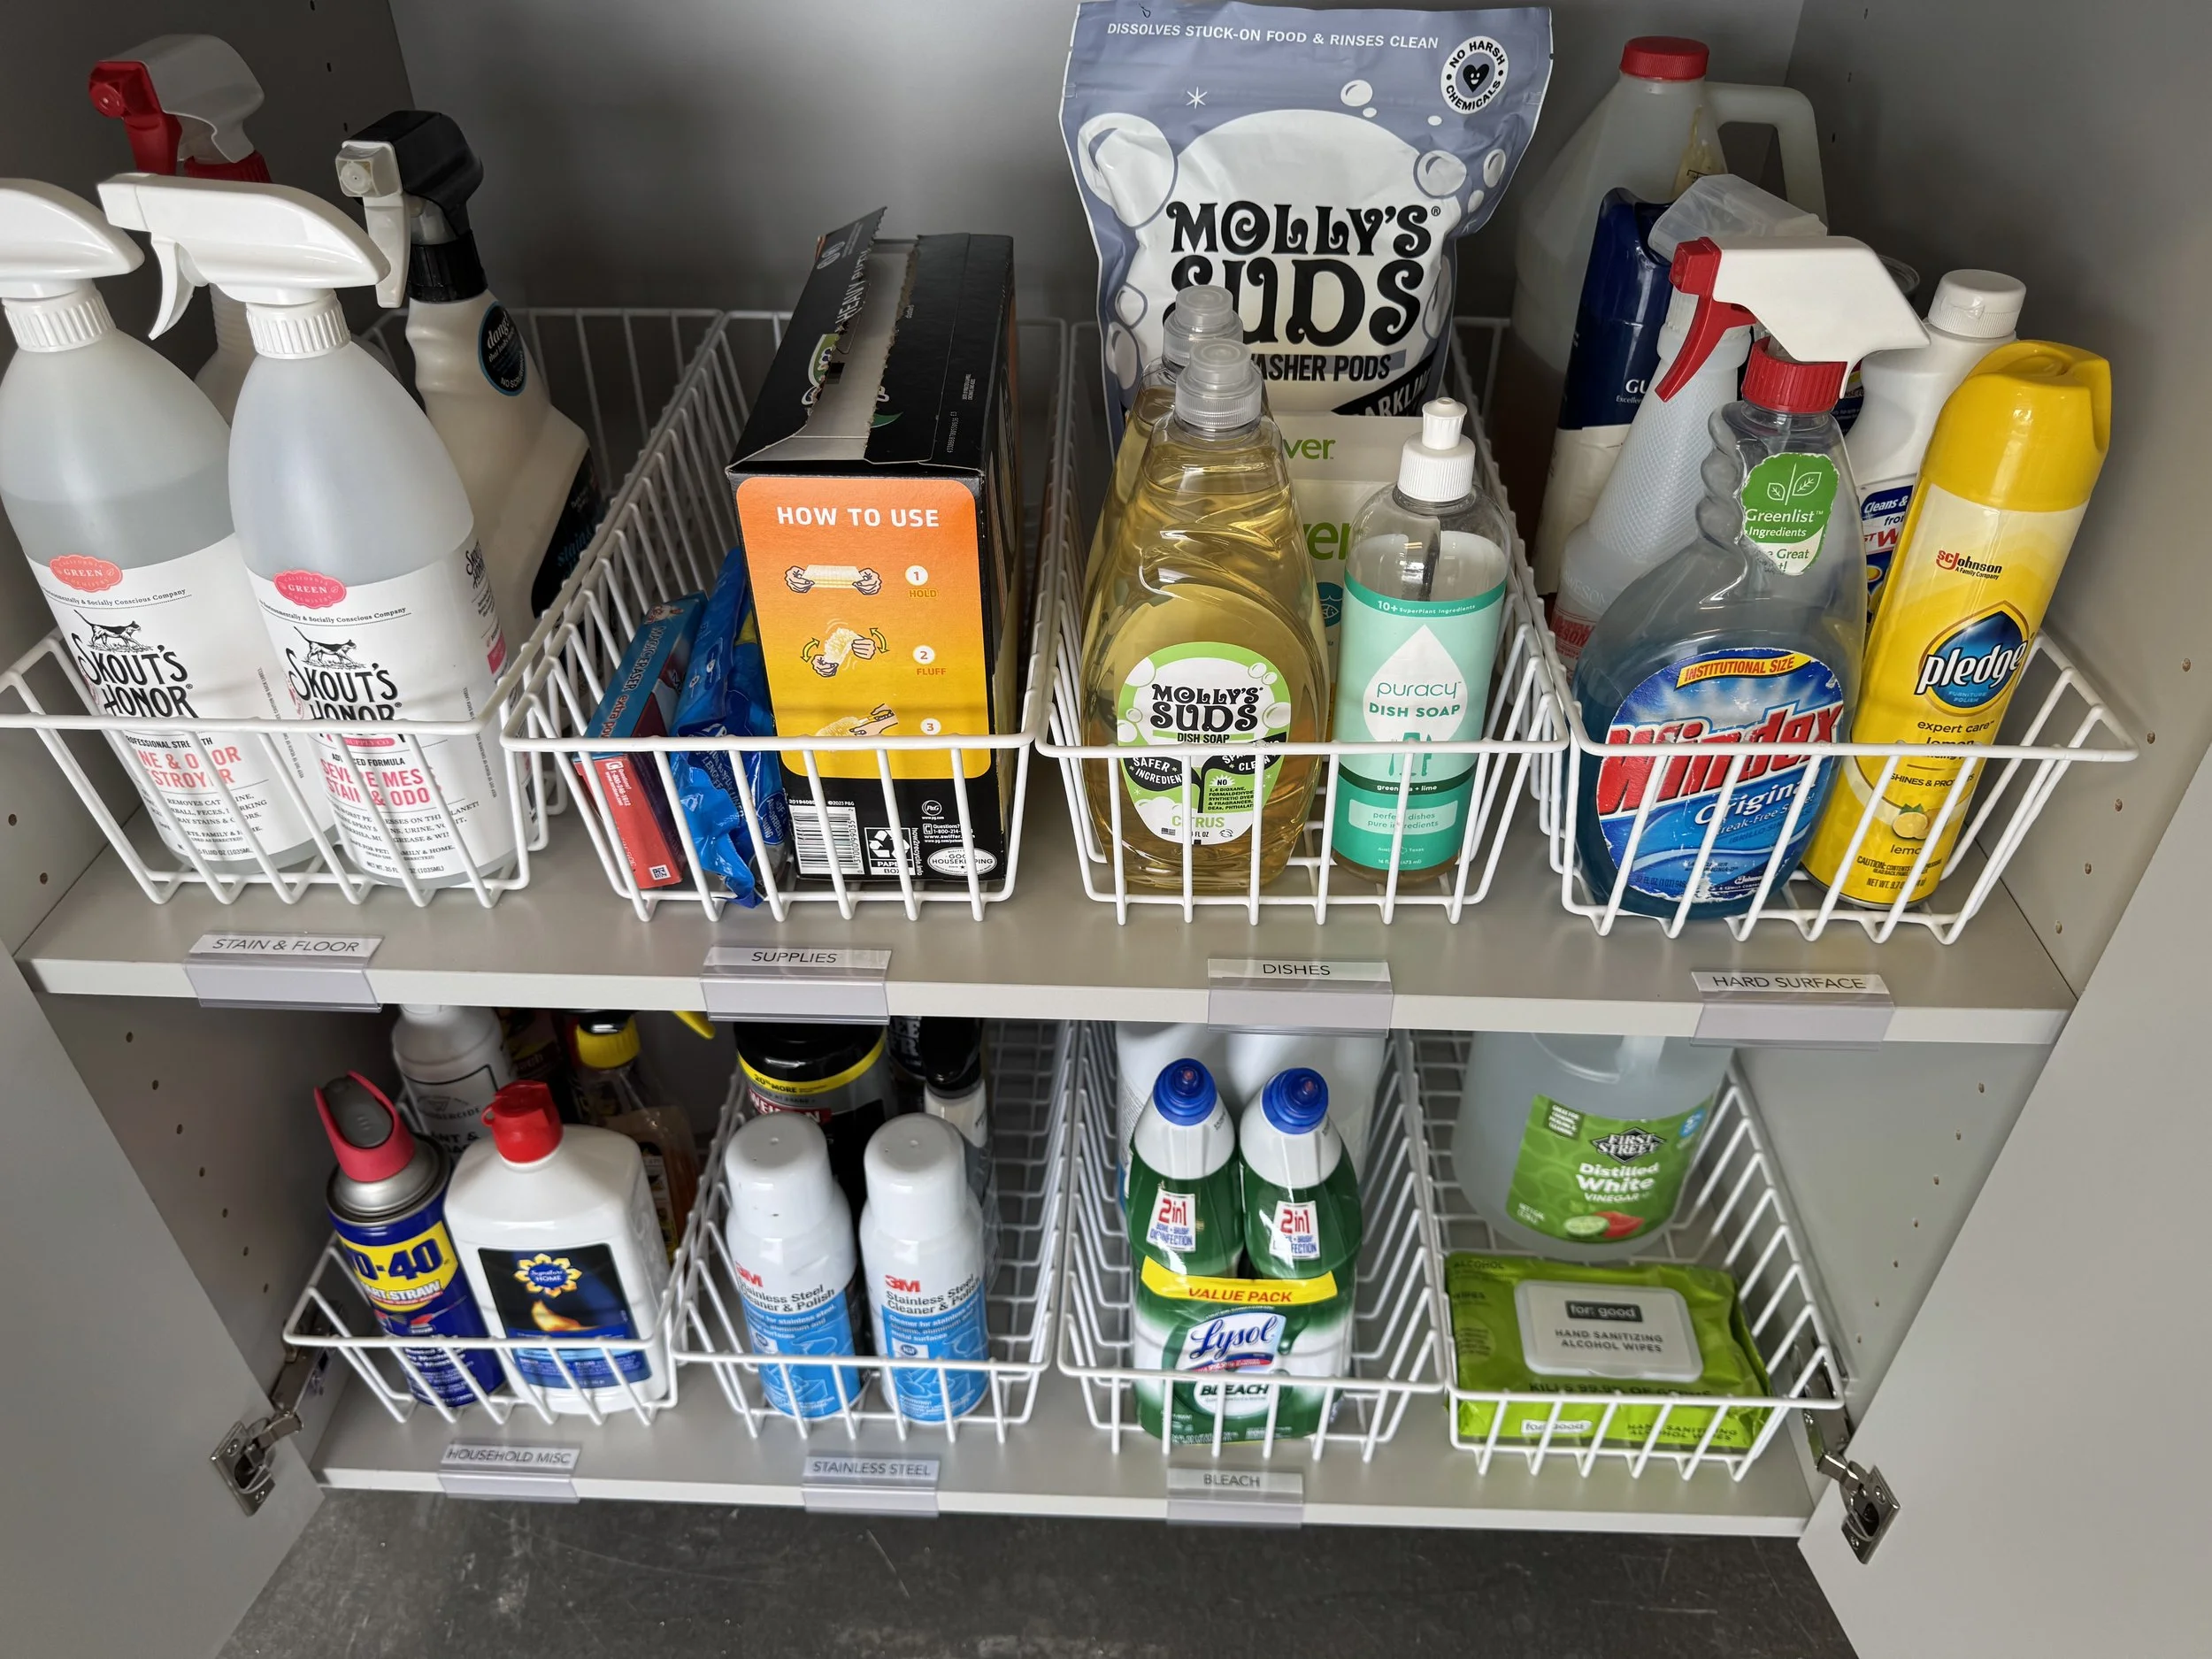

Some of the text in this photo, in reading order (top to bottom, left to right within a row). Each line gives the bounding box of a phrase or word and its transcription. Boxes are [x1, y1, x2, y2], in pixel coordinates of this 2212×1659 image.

[1107, 23, 1439, 50] DISSOLVES STUCK-ON FOOD & RINSES CLEAN
[1449, 41, 1506, 68] NO HARSH
[1446, 81, 1501, 111] CHEMICALS
[1166, 200, 1432, 258] MOLLY'S
[835, 279, 866, 327] HEAVY
[1333, 354, 1392, 382] PODS
[1864, 498, 1899, 514] Cleans
[777, 506, 940, 527] HOW TO USE
[1746, 509, 1814, 523] Greenlist
[1748, 526, 1807, 538] Ingredients
[1777, 549, 1809, 559] Great
[64, 568, 104, 577] GREEN
[1960, 567, 1977, 577] Family
[288, 584, 327, 594] GREEN
[909, 588, 937, 598] HOLD
[87, 588, 187, 607] Socially Conscious Company
[309, 606, 407, 624] Socially Conscious Company
[1378, 601, 1398, 612] 10+
[1439, 604, 1476, 614] Ingredients
[72, 633, 188, 686] SKOUT'S
[286, 648, 398, 703] SKOUT'S
[622, 658, 652, 692] ERASER
[916, 667, 947, 676] FLUFF
[1685, 657, 1795, 682] INSTITUTIONAL SIZE
[1915, 641, 2028, 695] pledge
[1151, 684, 1259, 704] MOLLY'S
[1377, 680, 1458, 699] puracy
[102, 683, 199, 718] HONOR
[607, 694, 629, 721] extra
[1149, 702, 1258, 733] SUDS
[1369, 703, 1461, 718] DISH SOAP
[1917, 721, 1989, 733] expert care
[173, 737, 213, 748] STRETH
[1178, 733, 1230, 743] DISH SOAP
[166, 754, 180, 769] &
[185, 746, 241, 769] OOR
[367, 757, 405, 766] FORMULA
[1133, 757, 1171, 772] SAFER
[1239, 755, 1271, 772] CLEN
[1597, 704, 1844, 816] Windex
[148, 768, 235, 788] STROYR
[382, 767, 434, 787] MES
[1135, 768, 1182, 784] INGREDIEN
[1890, 773, 1924, 787] SHINES
[167, 798, 204, 807] REMOVES
[390, 787, 432, 806] ODO
[1408, 812, 1435, 821] dishes
[404, 825, 434, 833] URINE,
[1890, 844, 1922, 855] lemo
[212, 939, 360, 952] STAIN & FLOOR
[752, 951, 837, 963] SUPPLIES
[1263, 964, 1331, 976] DISHES
[1712, 976, 1867, 989] HARD SURFACE
[772, 1081, 797, 1094] MORE
[1608, 1133, 1654, 1145] FIRST
[1597, 1142, 1659, 1156] STREET
[1579, 1162, 1660, 1178] Distilled
[1575, 1174, 1655, 1193] White
[1584, 1192, 1640, 1203] VINEGAR
[350, 1238, 443, 1280] D-40
[1454, 1260, 1504, 1270] ALCOHOL
[389, 1279, 442, 1301] STRAW
[885, 1274, 921, 1293] 3M
[887, 1273, 973, 1305] Stainless Steel
[783, 1289, 835, 1312] & Polish
[791, 1285, 824, 1302] Steel
[1188, 1287, 1293, 1302] VALUE PACK
[887, 1300, 935, 1314] Cleaner
[939, 1302, 949, 1311] &
[1598, 1305, 1637, 1319] good
[1189, 1316, 1278, 1360] Lysol
[1555, 1328, 1664, 1343] HAND SANITIZING
[1562, 1339, 1663, 1353] ALCOHOL WIPES
[446, 1448, 572, 1463] HOUSEHOLD MISC
[813, 1461, 931, 1476] STAINLESS STEEL
[1203, 1473, 1260, 1487] BLEACH
